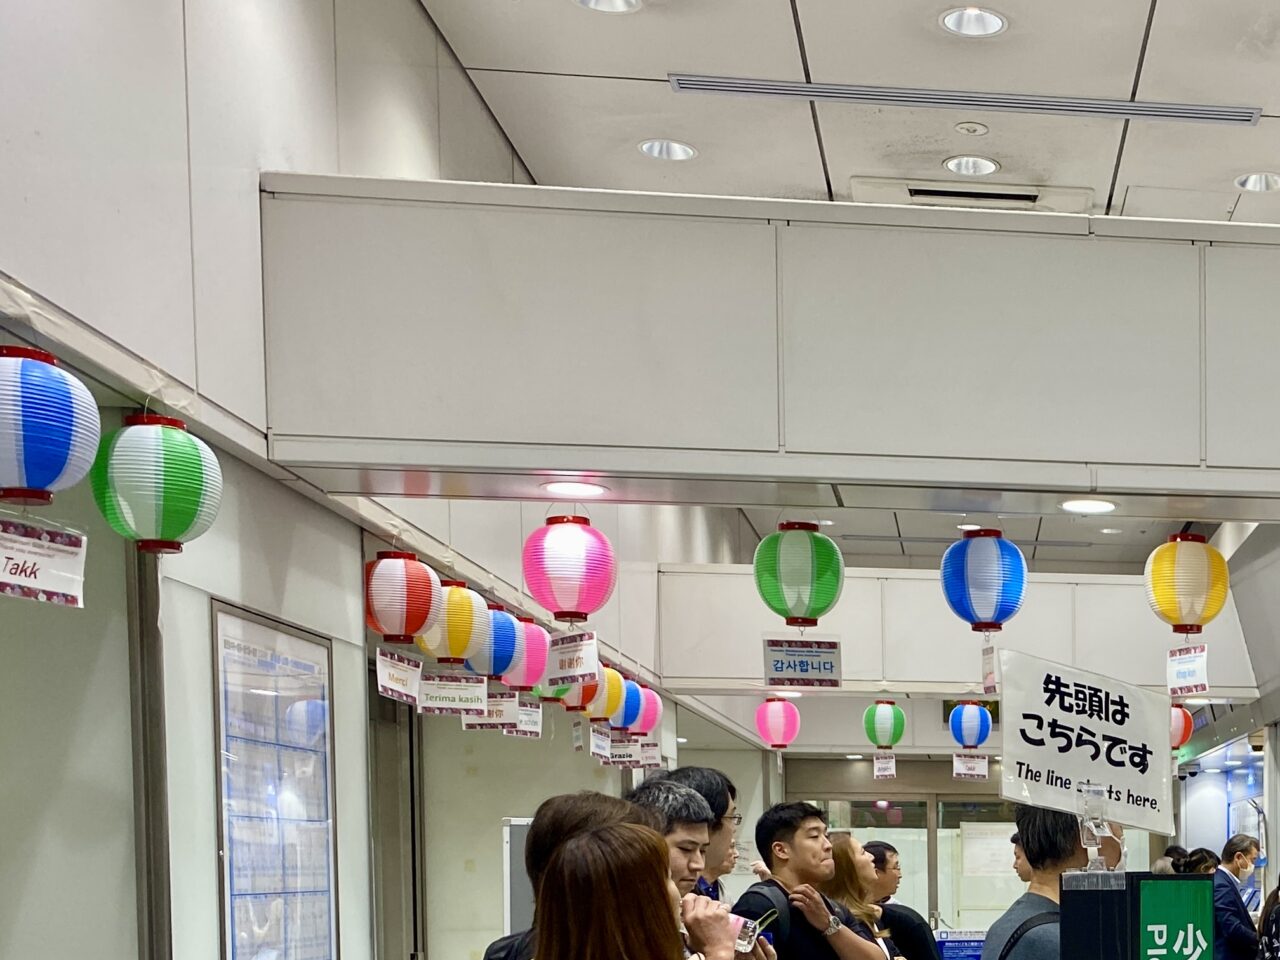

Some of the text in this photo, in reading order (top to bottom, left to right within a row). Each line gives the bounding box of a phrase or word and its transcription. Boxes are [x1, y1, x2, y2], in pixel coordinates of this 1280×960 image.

[3, 556, 40, 579] Takk
[773, 660, 834, 673] 감사합니다
[388, 672, 408, 687] Merci
[424, 694, 483, 704] Terima kasih
[1043, 673, 1130, 726] 先頭は
[1019, 713, 1153, 775] こちらです
[1016, 761, 1041, 782] The
[1046, 769, 1072, 790] line
[1126, 789, 1160, 813] here.
